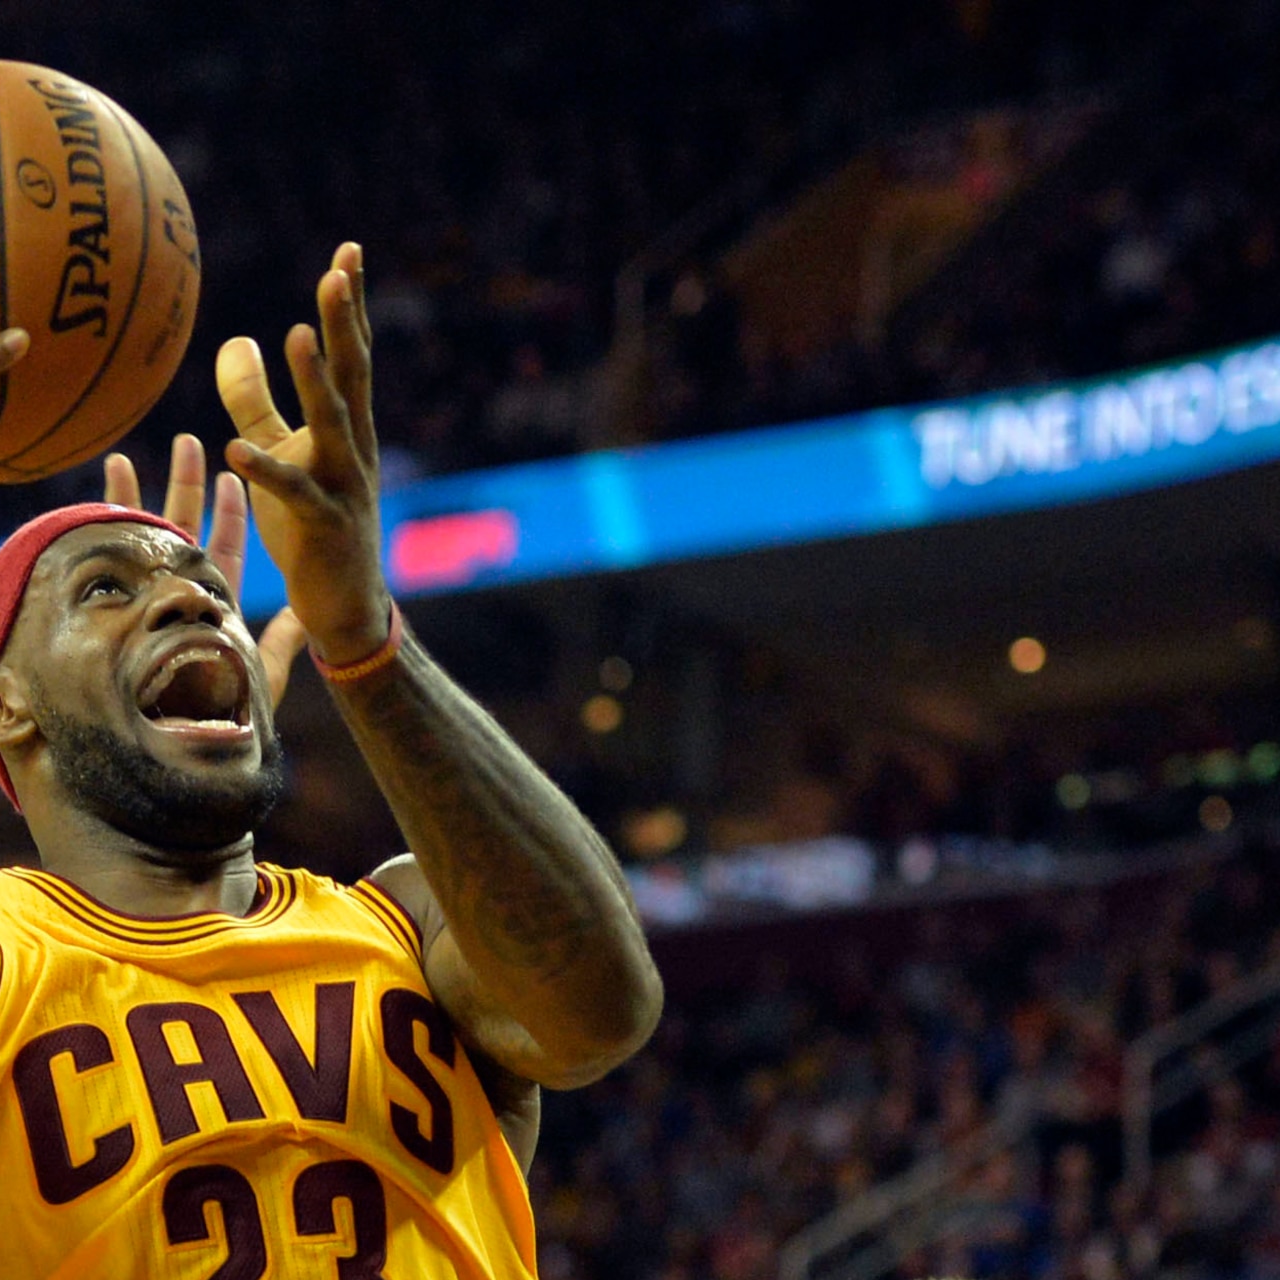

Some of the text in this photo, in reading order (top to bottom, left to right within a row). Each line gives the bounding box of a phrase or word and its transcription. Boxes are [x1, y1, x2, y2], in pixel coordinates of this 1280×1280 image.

[28, 77, 112, 338] SPALDING
[913, 390, 1080, 489] TUNE
[12, 980, 457, 1206] CAVS
